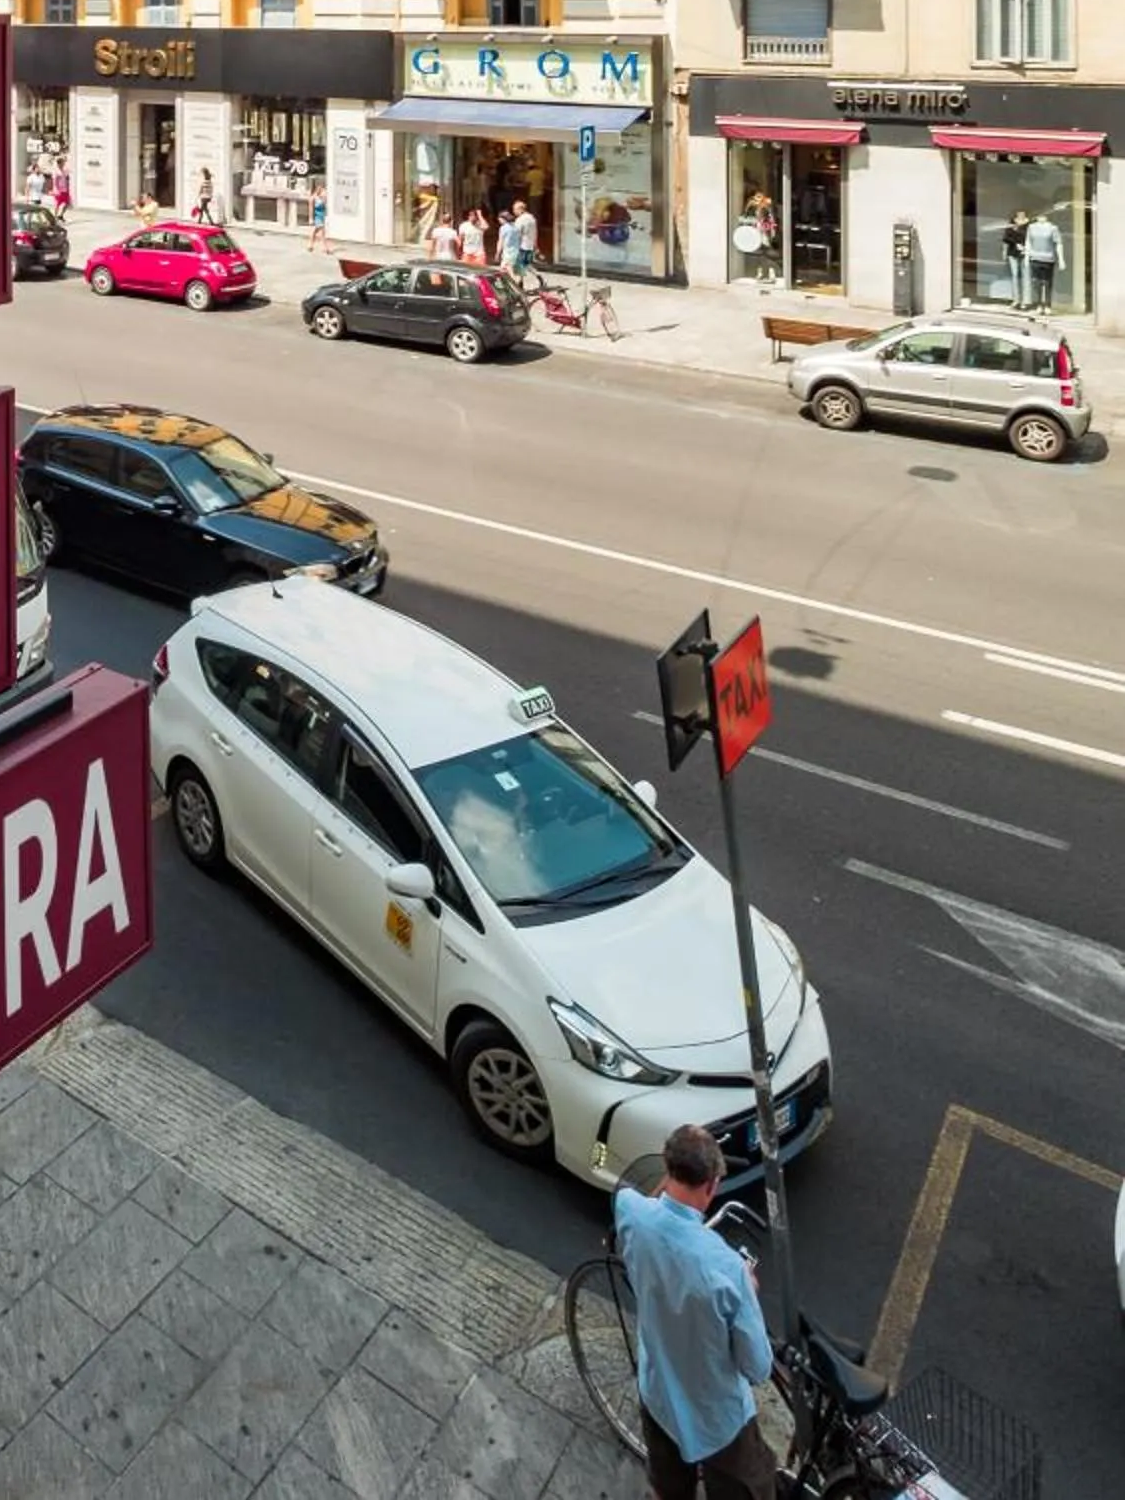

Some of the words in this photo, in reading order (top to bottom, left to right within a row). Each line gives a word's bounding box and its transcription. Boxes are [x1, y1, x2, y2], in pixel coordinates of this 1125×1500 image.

[94, 38, 196, 78] Stroili
[412, 47, 640, 82] GROM
[832, 88, 899, 106] elena
